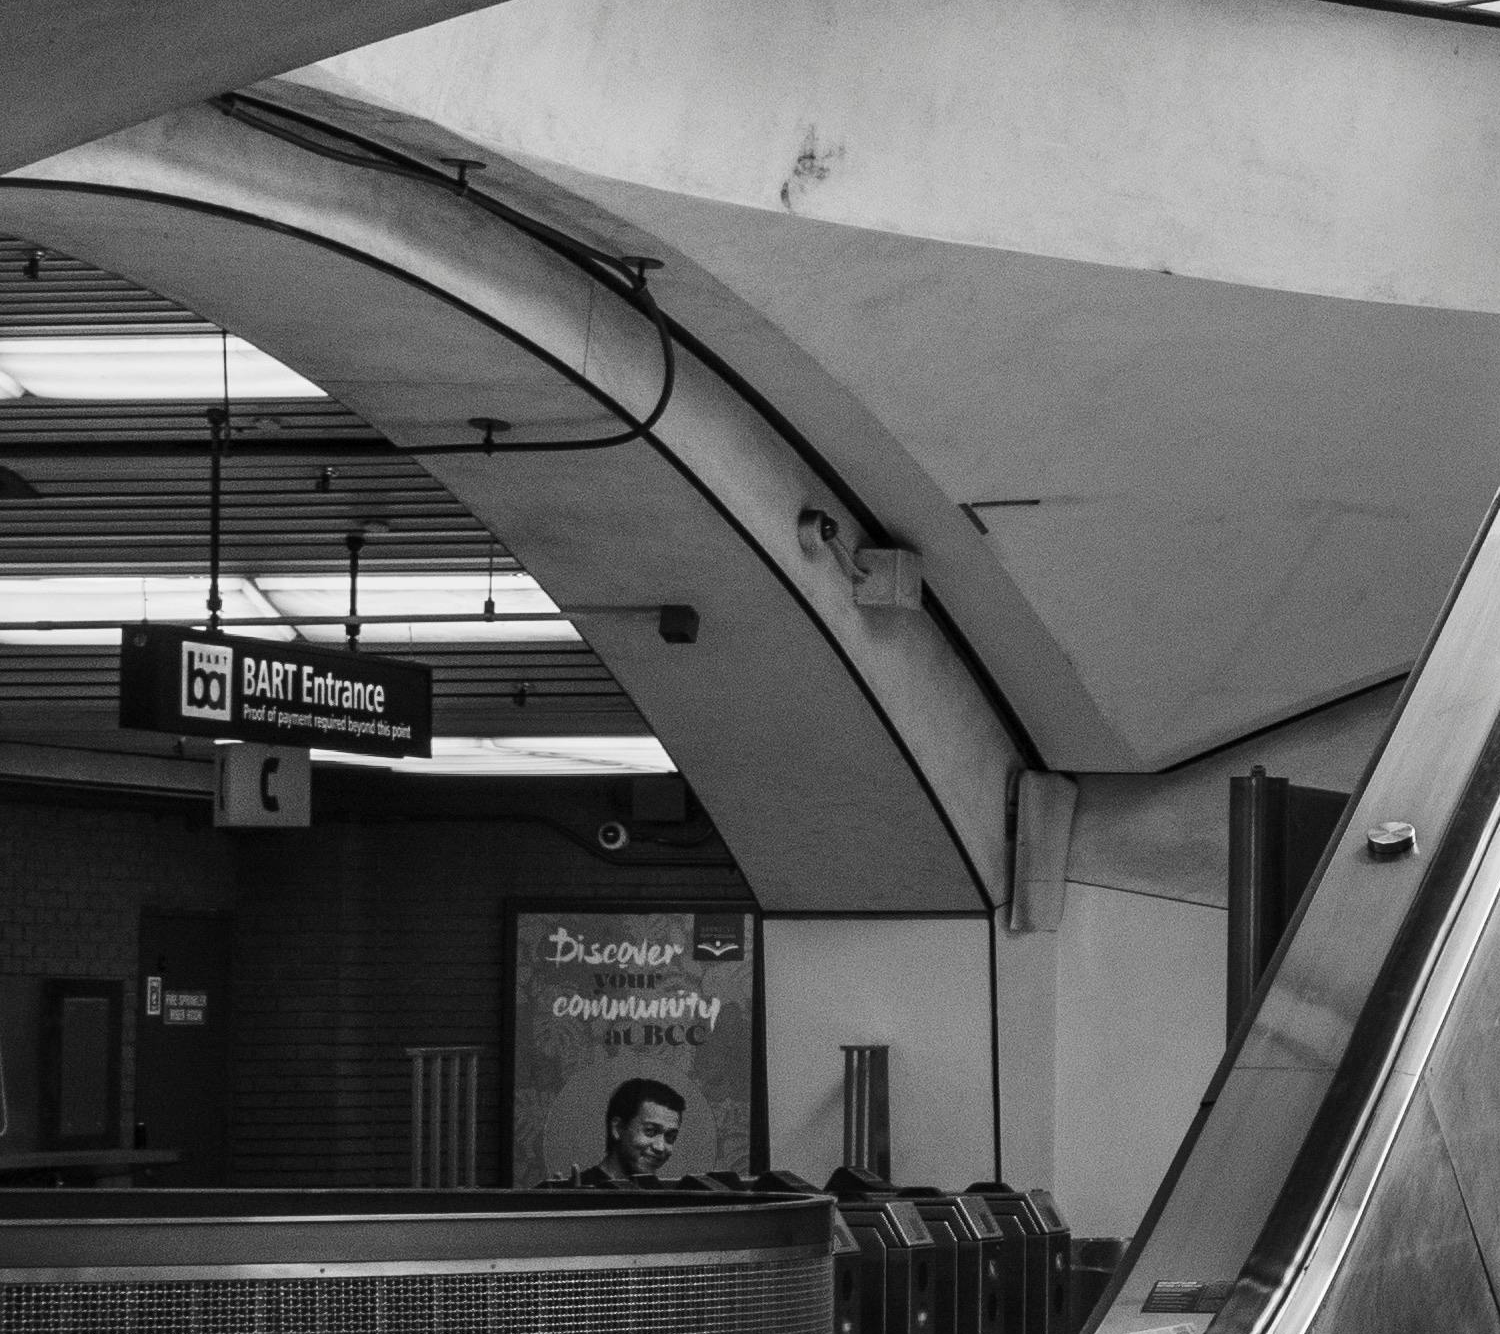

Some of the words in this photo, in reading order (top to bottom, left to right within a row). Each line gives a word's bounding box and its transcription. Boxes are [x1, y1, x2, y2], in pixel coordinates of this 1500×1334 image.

[243, 657, 297, 701] BART
[302, 665, 385, 713] Entrance
[243, 704, 266, 723] Proof
[267, 707, 277, 723] of
[278, 710, 313, 729] payment
[314, 714, 347, 733] required
[348, 716, 376, 737] beyond
[377, 721, 391, 737] this
[392, 722, 412, 740] point
[545, 927, 685, 969] Discover
[594, 972, 663, 995] your
[552, 989, 721, 1032] community
[604, 1025, 634, 1046] at
[644, 1024, 706, 1047] BCC
